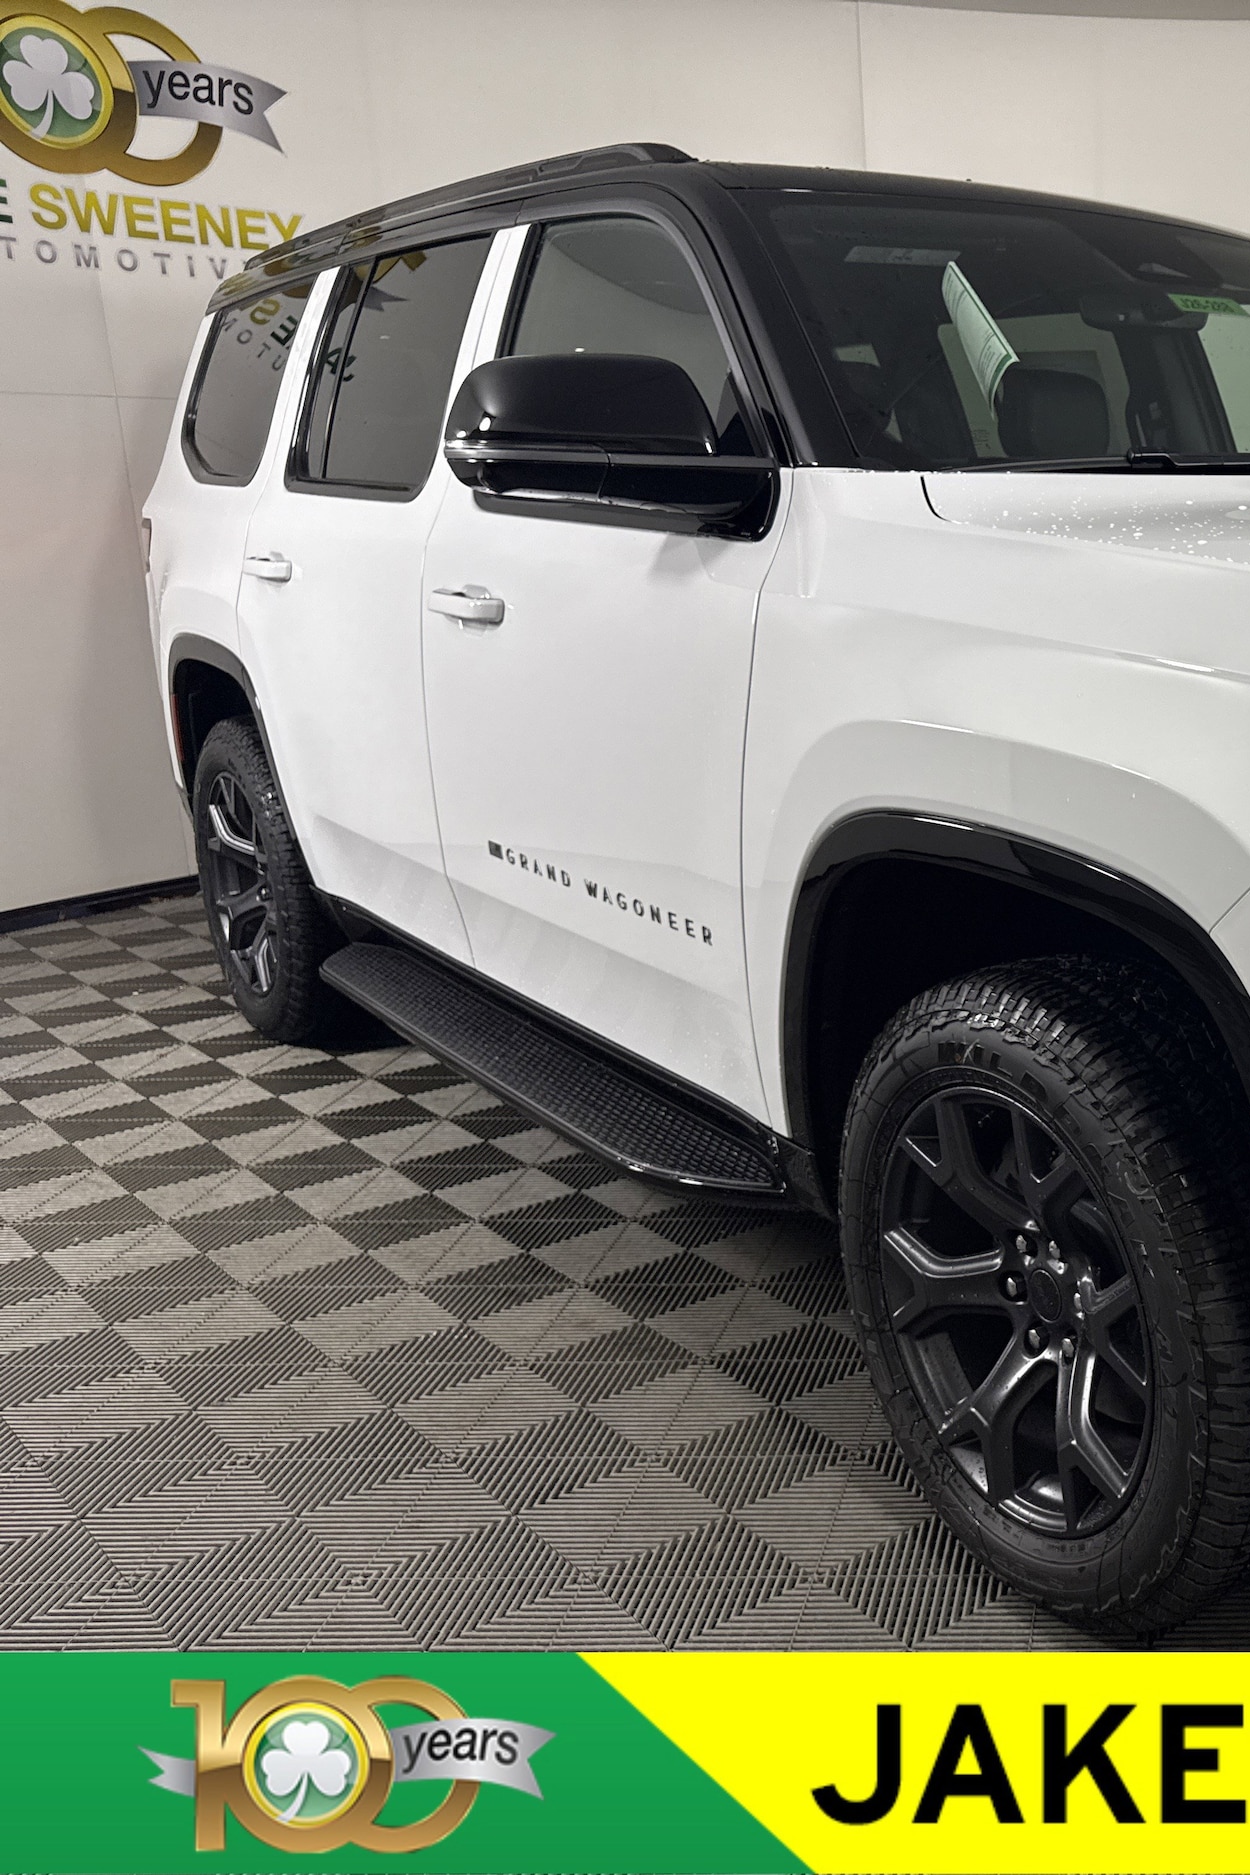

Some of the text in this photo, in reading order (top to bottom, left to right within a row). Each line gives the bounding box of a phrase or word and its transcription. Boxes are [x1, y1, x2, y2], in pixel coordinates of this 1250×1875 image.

[142, 66, 255, 115] years
[0, 236, 228, 279] TOMOTIV
[505, 847, 714, 946] GRAND WAGONEER
